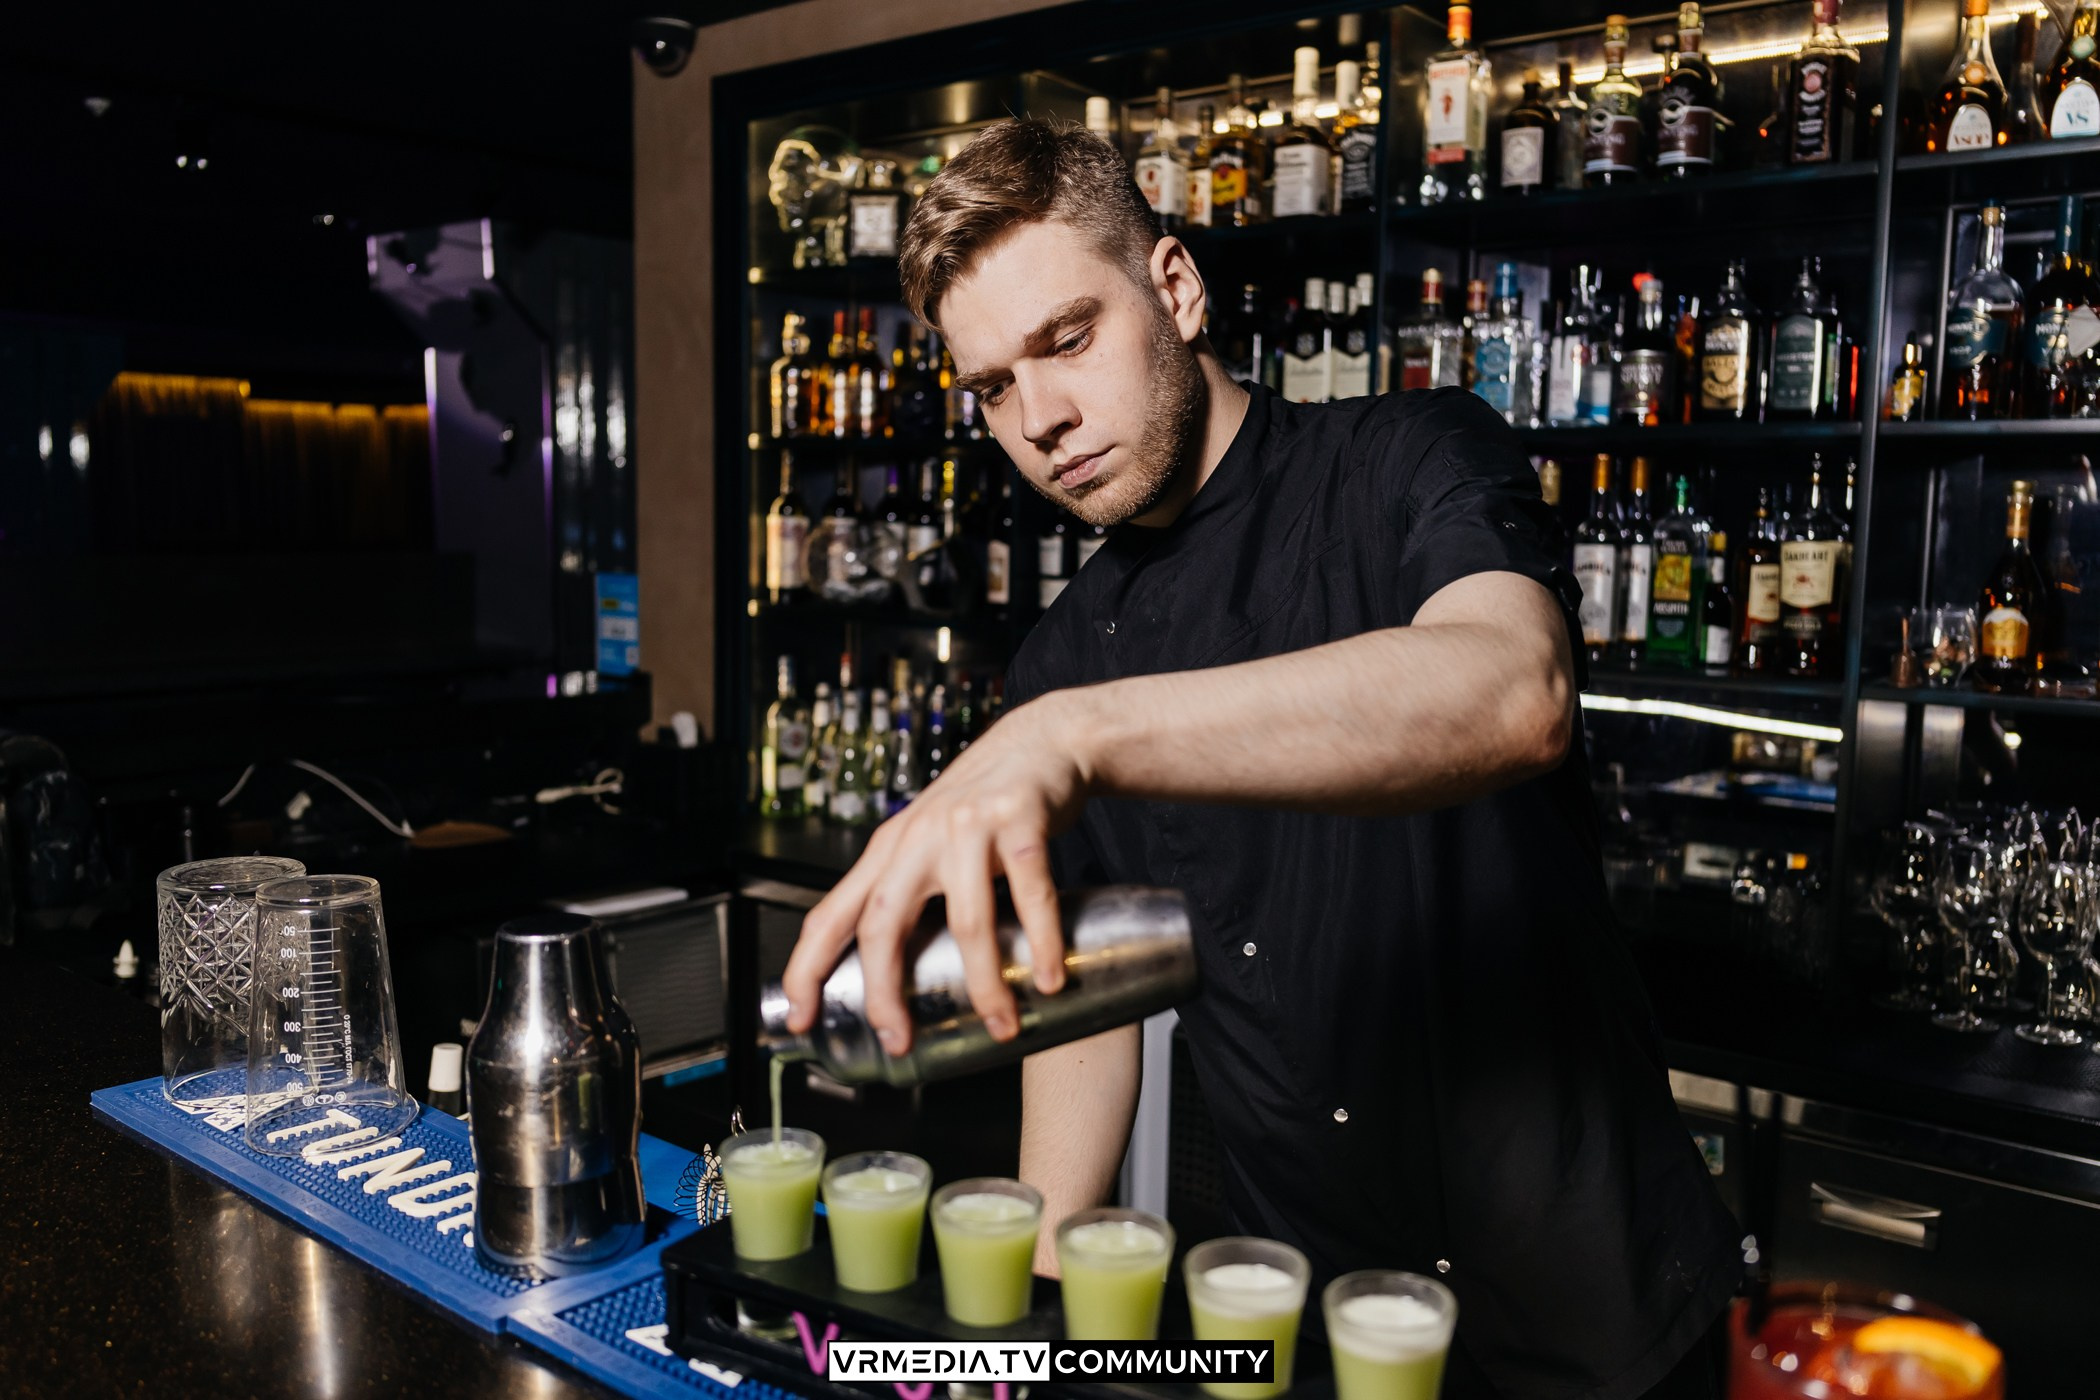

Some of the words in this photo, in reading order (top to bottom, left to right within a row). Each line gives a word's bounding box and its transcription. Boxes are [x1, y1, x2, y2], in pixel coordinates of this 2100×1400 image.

[283, 925, 296, 936] 50
[281, 947, 297, 958] 100
[282, 987, 300, 998] 200
[284, 1021, 302, 1033] 300
[285, 1053, 303, 1064] 400
[286, 1082, 304, 1093] 500
[266, 1108, 476, 1248] TUND
